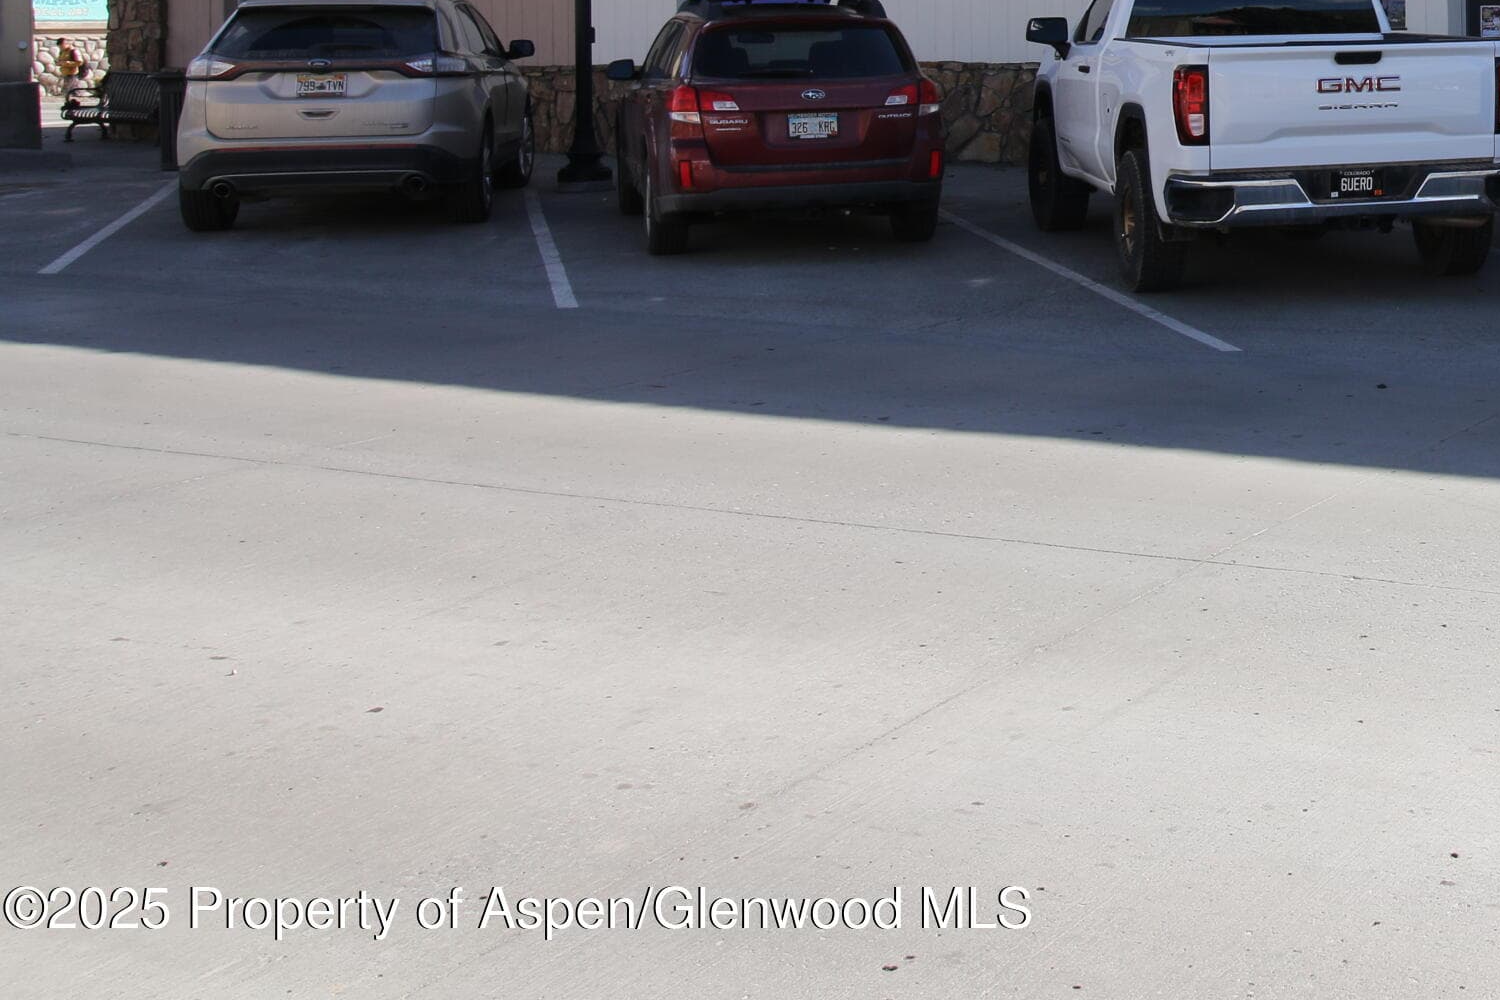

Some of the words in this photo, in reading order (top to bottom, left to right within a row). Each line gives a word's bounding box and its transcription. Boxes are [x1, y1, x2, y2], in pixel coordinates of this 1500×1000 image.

[326, 80, 345, 91] TVN
[1316, 76, 1401, 94] GMC
[792, 122, 808, 134] 326
